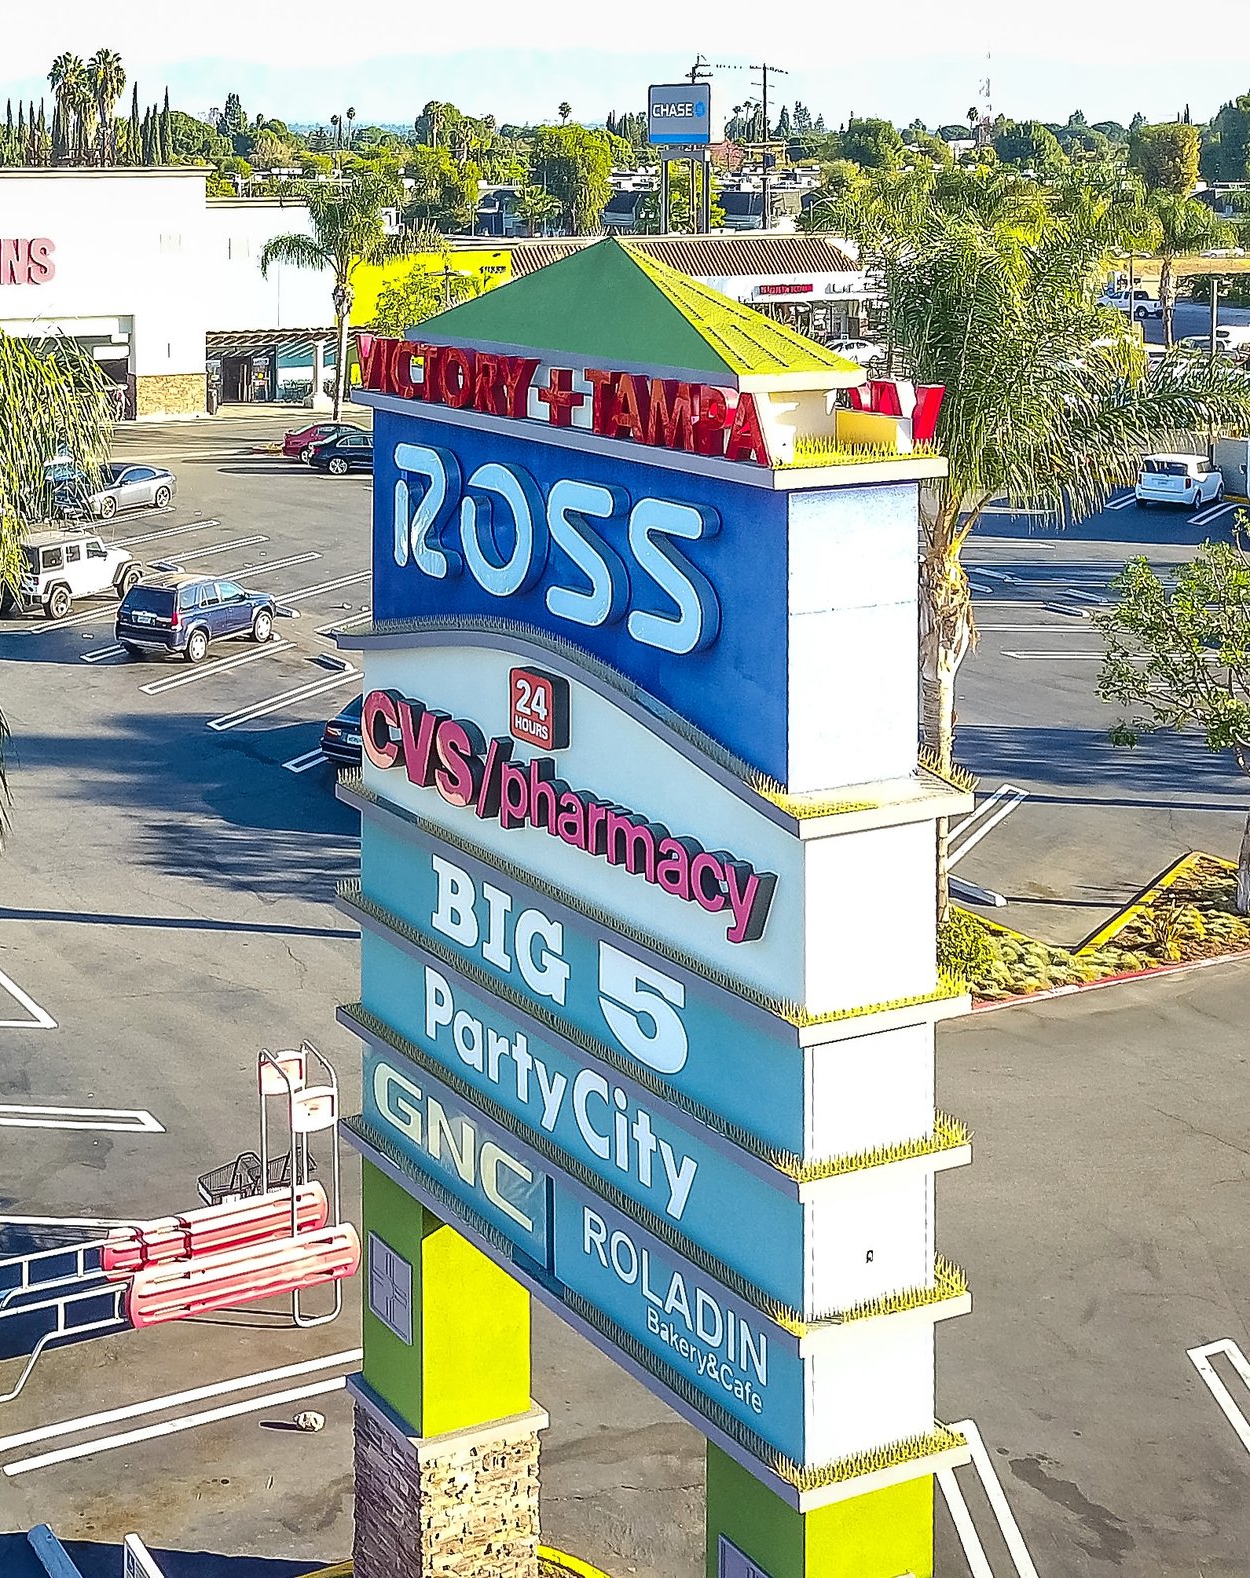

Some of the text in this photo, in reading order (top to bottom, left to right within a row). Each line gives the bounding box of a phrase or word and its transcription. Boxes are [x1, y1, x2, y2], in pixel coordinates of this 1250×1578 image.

[652, 103, 693, 117] CHASE
[355, 334, 540, 418] VICTORY
[585, 367, 774, 467] TAMPA
[393, 442, 720, 655] ROSS
[514, 714, 549, 740] HOURS
[515, 678, 548, 721] 24
[361, 689, 776, 943] CVS/pharmacy
[430, 854, 689, 1075] BIG 5
[372, 1060, 535, 1234] GNC
[581, 1206, 768, 1388] ROLADIN
